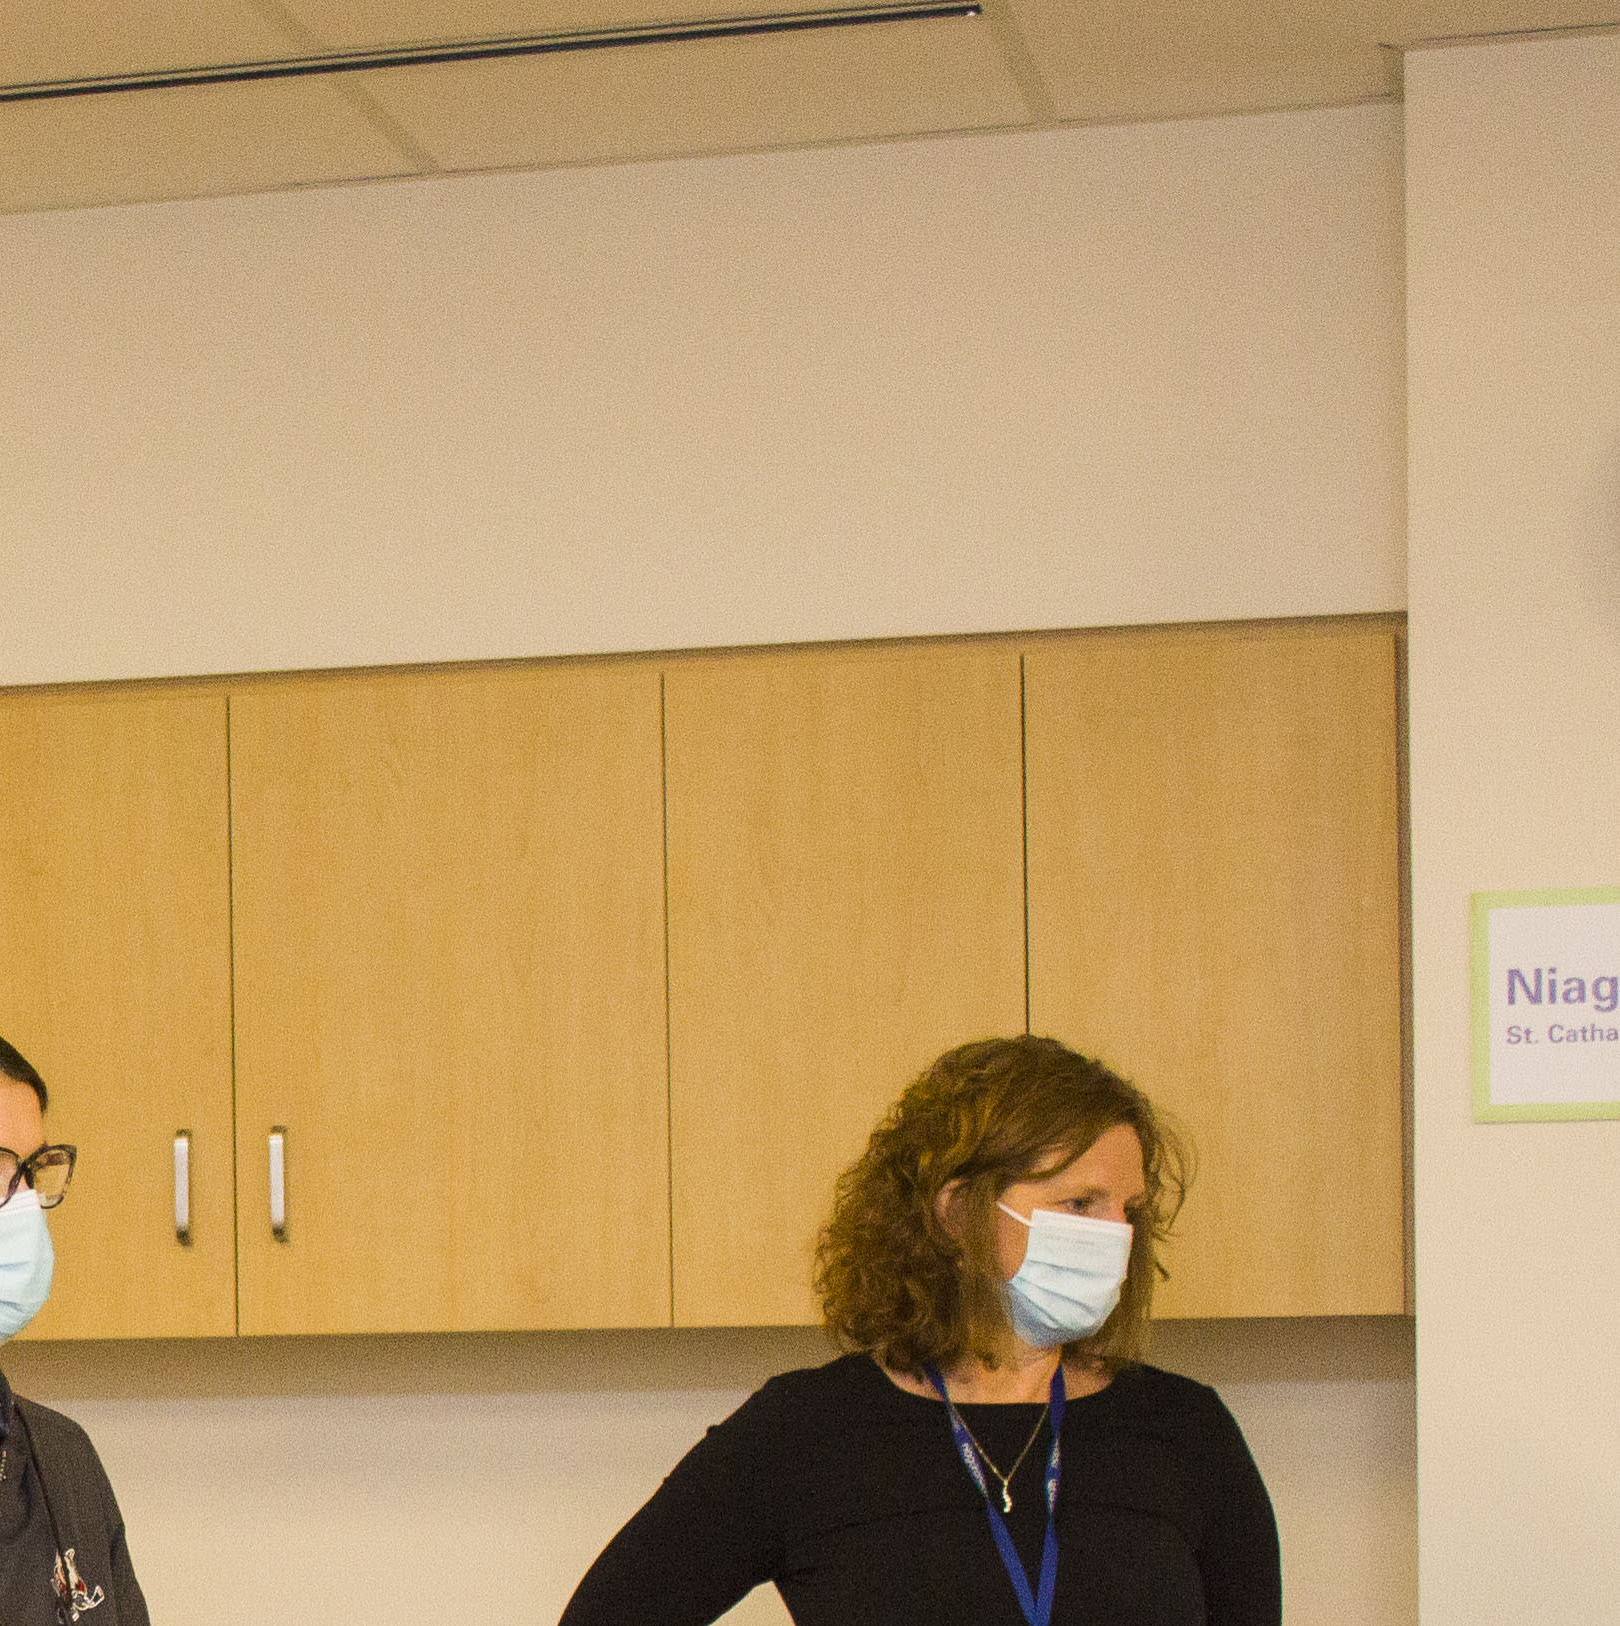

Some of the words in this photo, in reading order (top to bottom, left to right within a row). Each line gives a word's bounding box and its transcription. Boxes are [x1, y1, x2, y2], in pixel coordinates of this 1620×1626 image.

[1506, 967, 1619, 1013] Niag
[1506, 1025, 1539, 1045] St.
[1547, 1023, 1619, 1044] Catha
